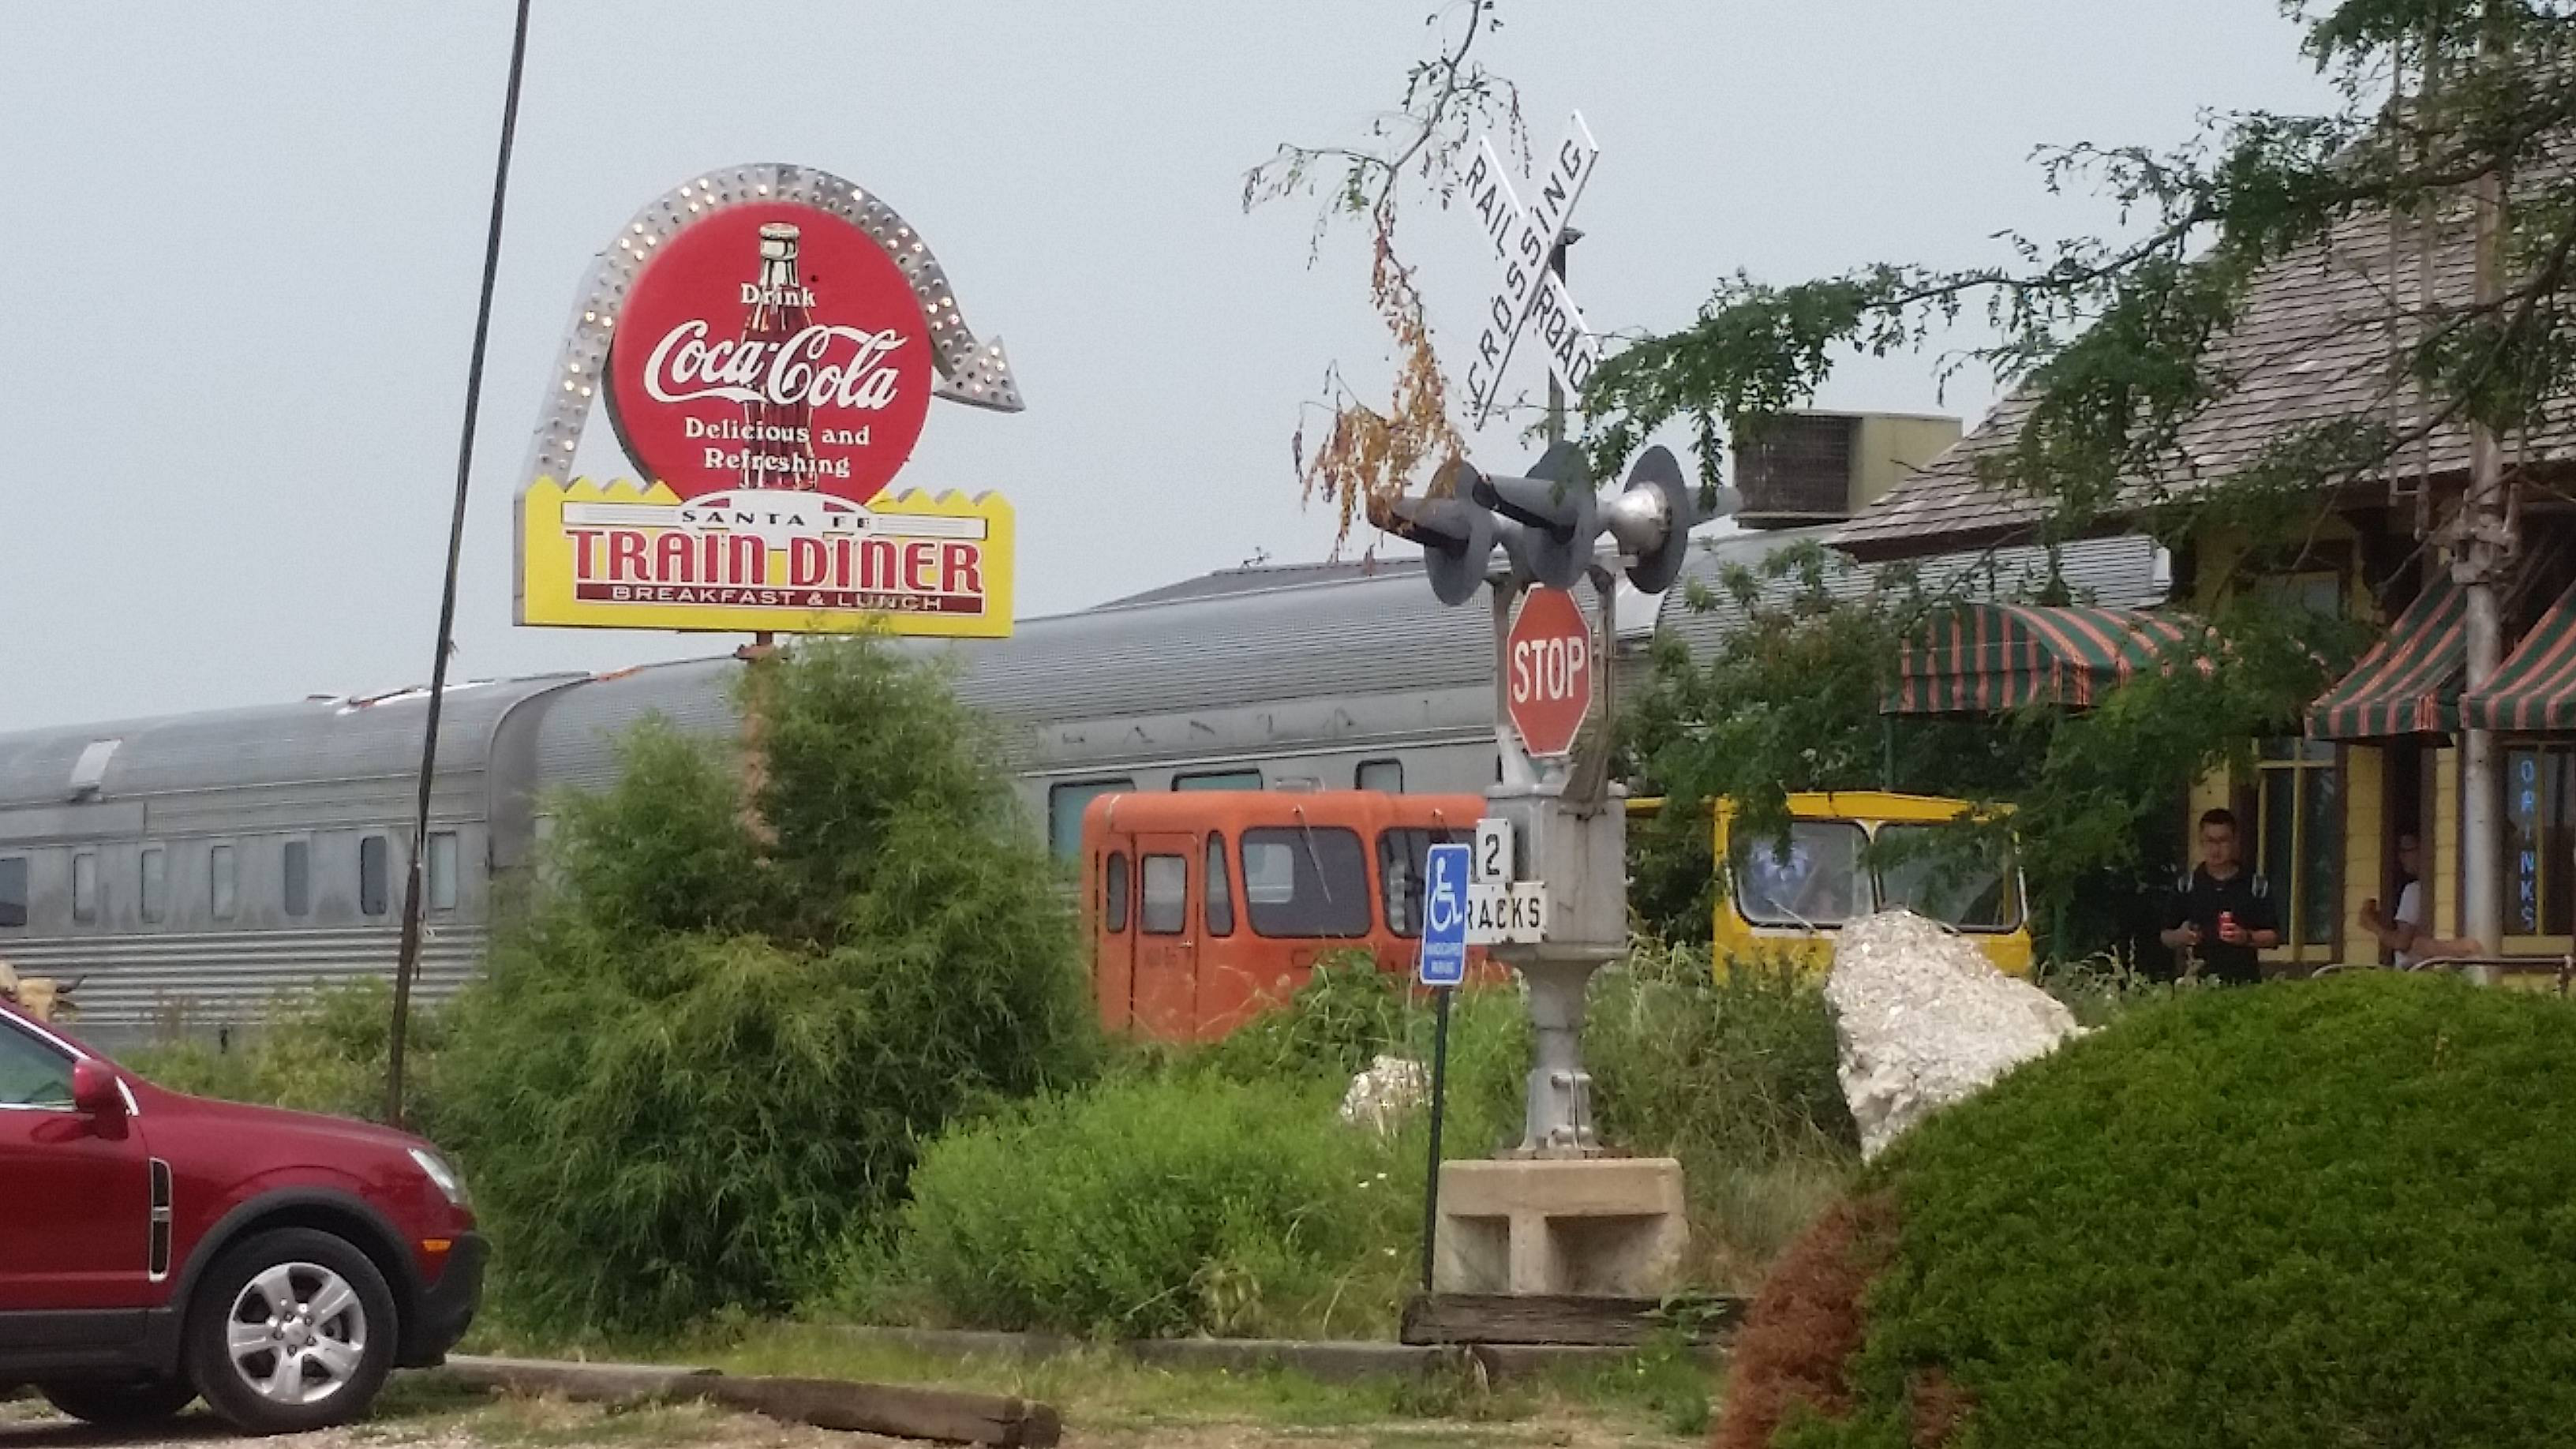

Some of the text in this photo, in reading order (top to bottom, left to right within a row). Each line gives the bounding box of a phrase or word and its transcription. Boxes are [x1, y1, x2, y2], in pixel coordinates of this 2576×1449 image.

[1465, 155, 1592, 391] RAIL ROAD
[1468, 140, 1581, 404] CROSSING
[740, 283, 816, 307] Drink
[685, 417, 870, 446] Delicious and
[704, 448, 850, 477] Refreshing
[682, 510, 871, 529] SANTA FE
[612, 587, 942, 612] BREAKFAST & LUNCH
[1514, 638, 1586, 704] STOP
[1485, 833, 1500, 876] 2
